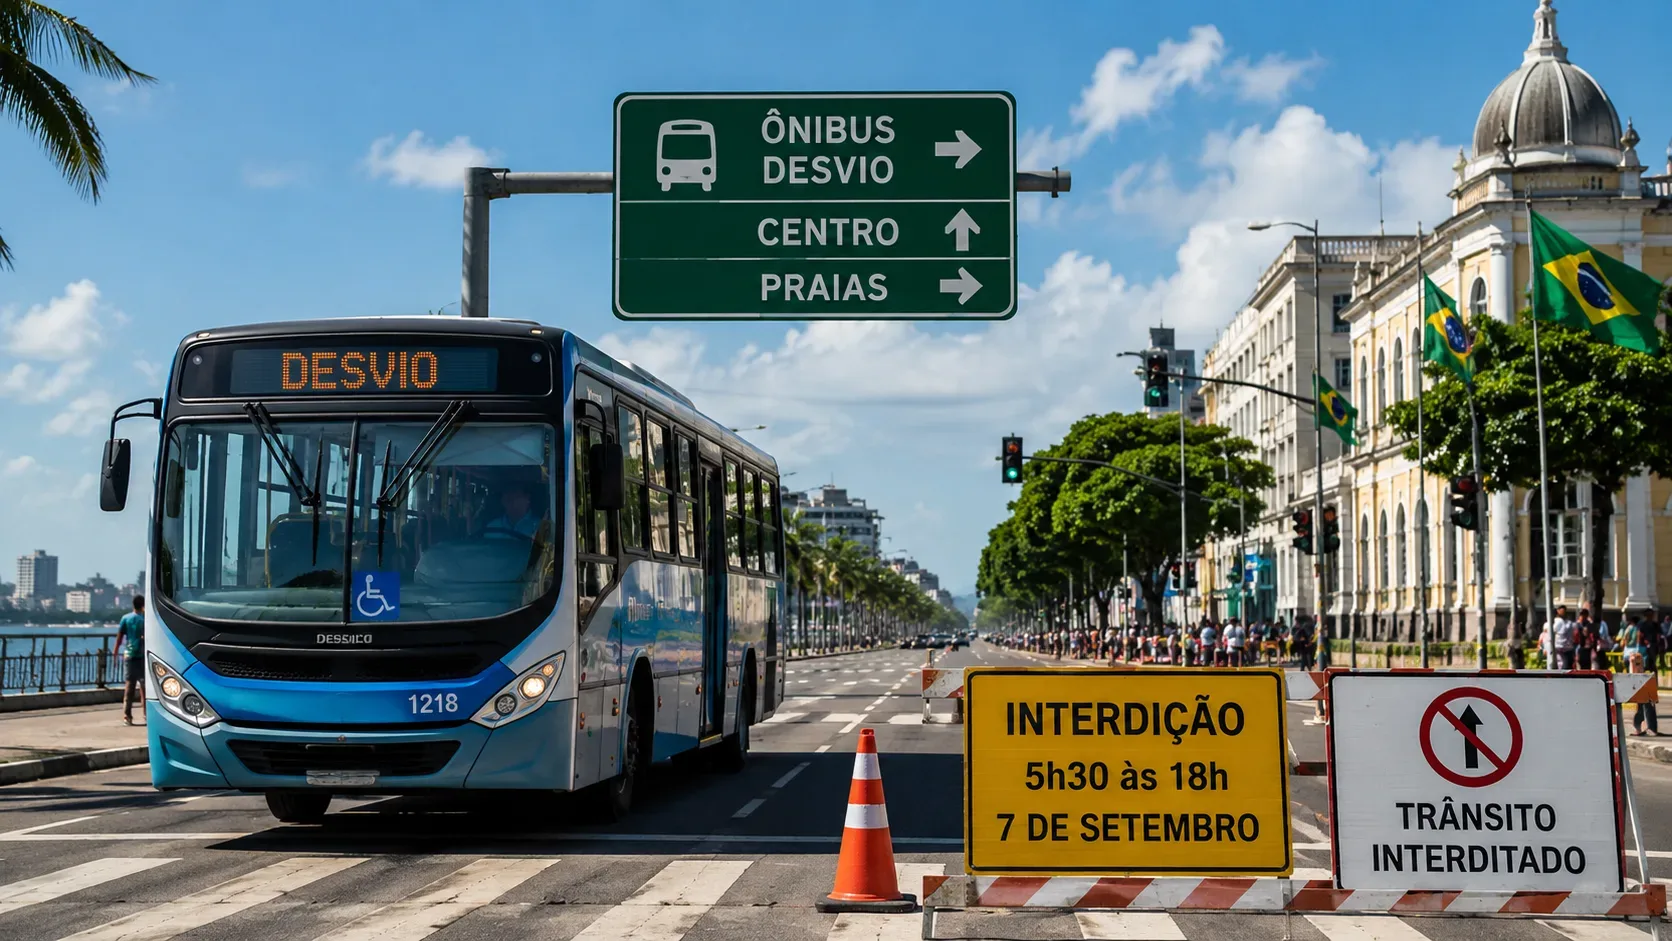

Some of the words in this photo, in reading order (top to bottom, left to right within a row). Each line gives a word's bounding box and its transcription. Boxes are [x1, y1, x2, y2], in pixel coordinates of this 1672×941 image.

[761, 108, 896, 144] ÔNIBUS
[763, 155, 895, 184] DESVIO
[757, 217, 900, 247] CENTRO
[761, 273, 888, 302] PRAIAS
[281, 351, 439, 391] DESVIO
[408, 693, 459, 714] 1218
[1006, 694, 1246, 745] INTERDIÇÃO
[1025, 761, 1109, 791] 5h30
[1120, 760, 1158, 791] às
[1170, 761, 1229, 791] 18h
[996, 813, 1015, 842] 7
[1027, 813, 1069, 842] DE
[1080, 812, 1260, 842] SETEMBRO
[1395, 795, 1557, 832] TRÂNSITO
[1372, 843, 1587, 875] INTERDITADO
